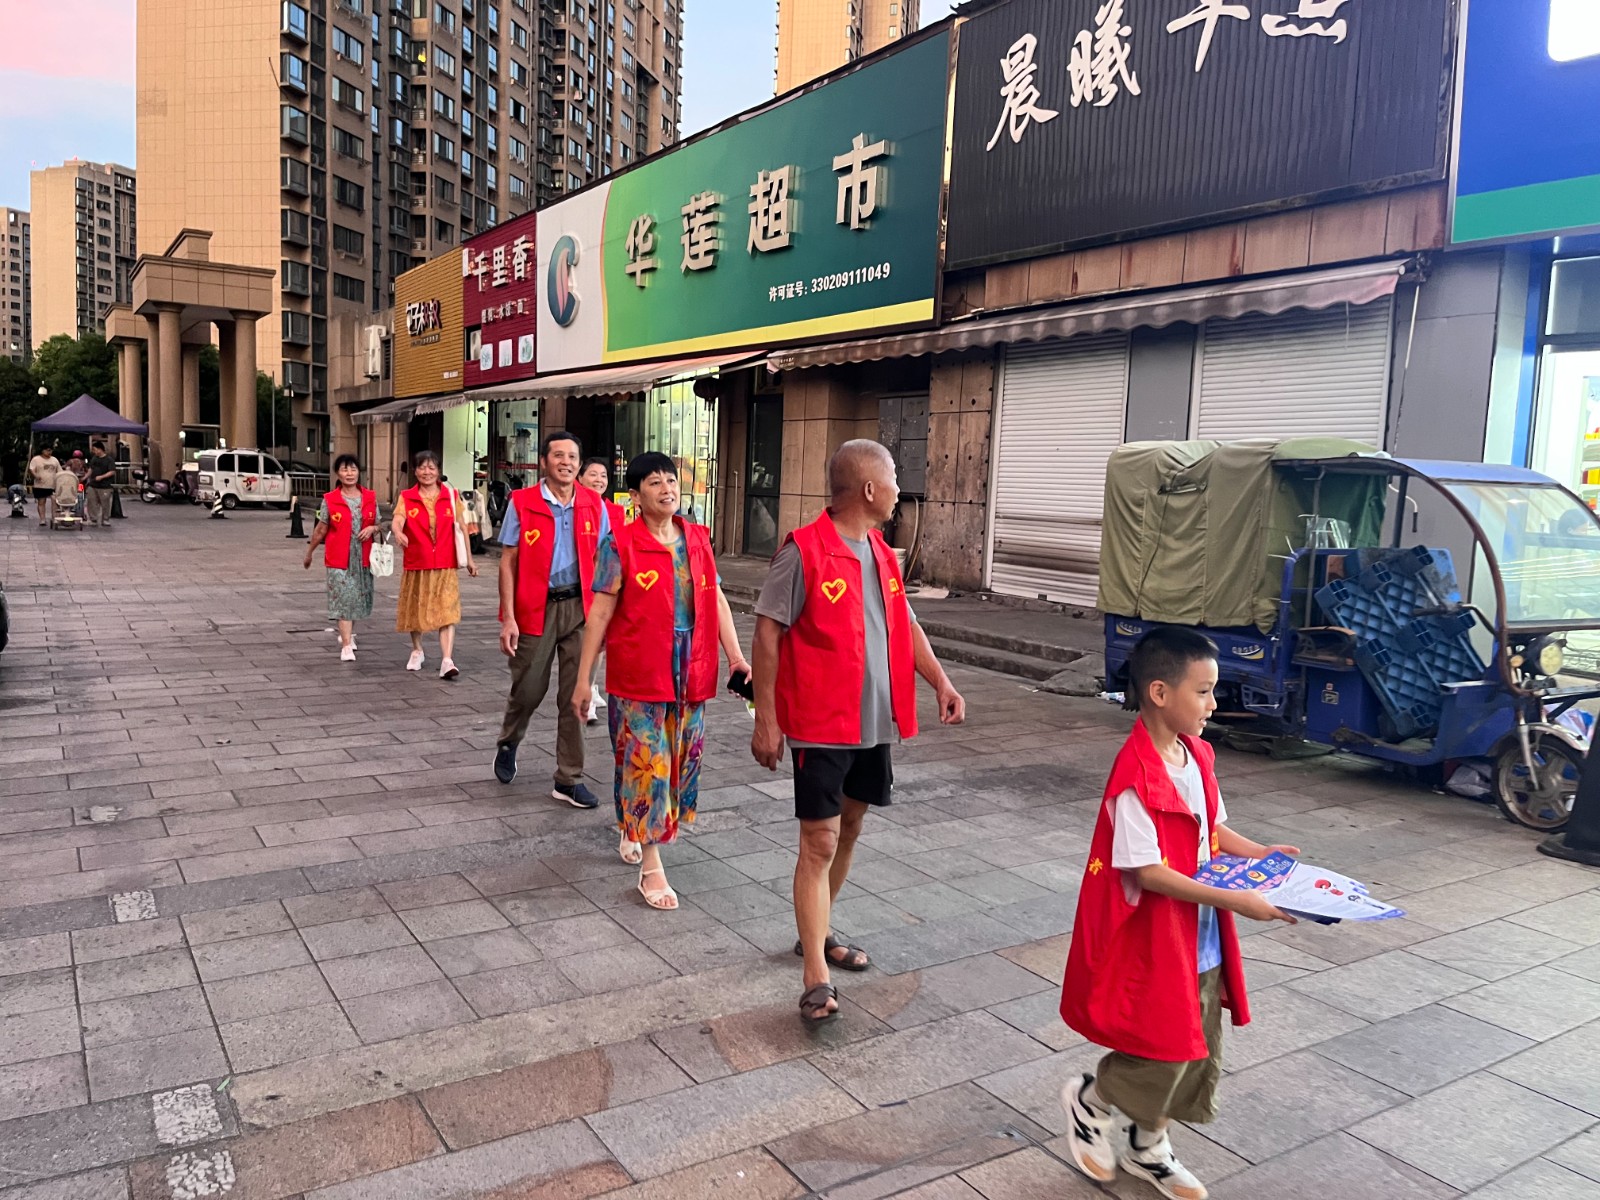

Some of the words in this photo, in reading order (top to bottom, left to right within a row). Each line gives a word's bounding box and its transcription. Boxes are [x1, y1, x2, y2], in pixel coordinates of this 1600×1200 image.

[625, 132, 890, 288] 华莲超市
[472, 235, 534, 293] 千里香
[768, 262, 891, 302] 许可证号：330209111049
